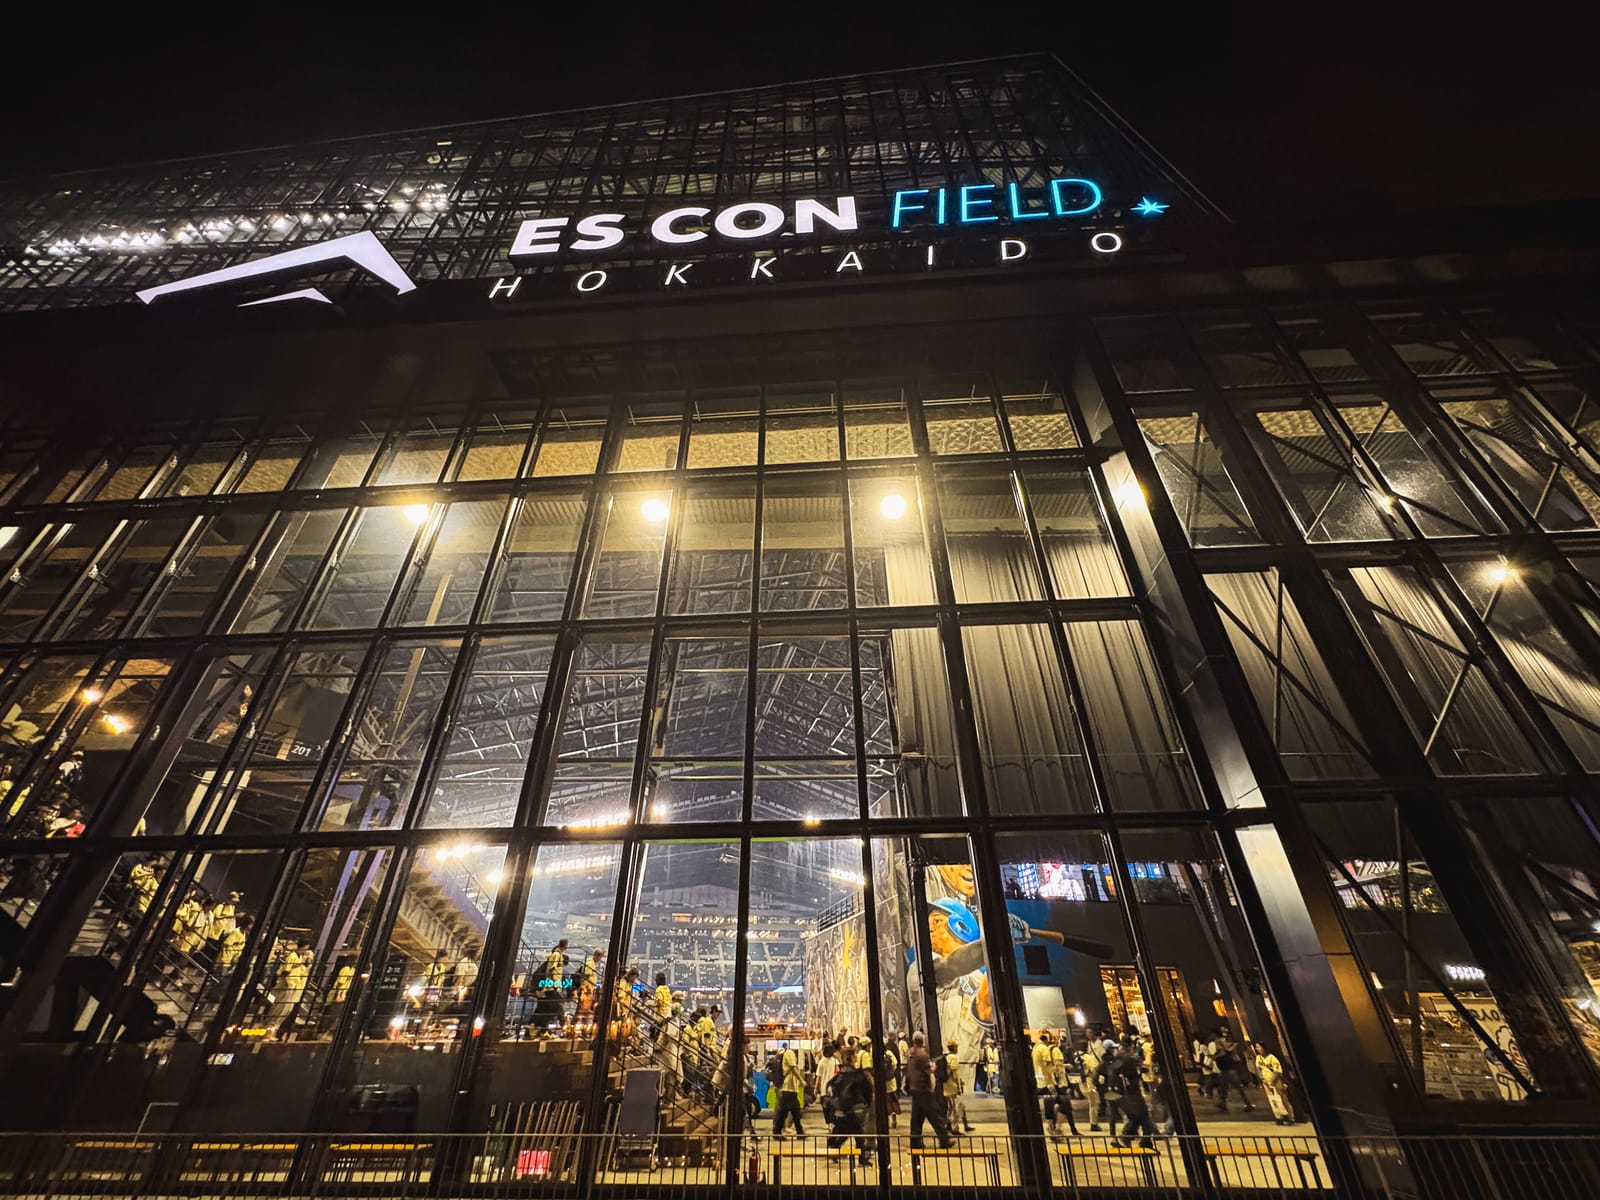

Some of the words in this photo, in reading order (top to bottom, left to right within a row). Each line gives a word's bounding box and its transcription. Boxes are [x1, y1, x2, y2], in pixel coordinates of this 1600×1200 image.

[509, 213, 627, 256] ES
[651, 196, 858, 244] CON
[892, 178, 1103, 228] FIELD
[488, 232, 1123, 299] HOKKAIDO
[291, 744, 312, 757] 201
